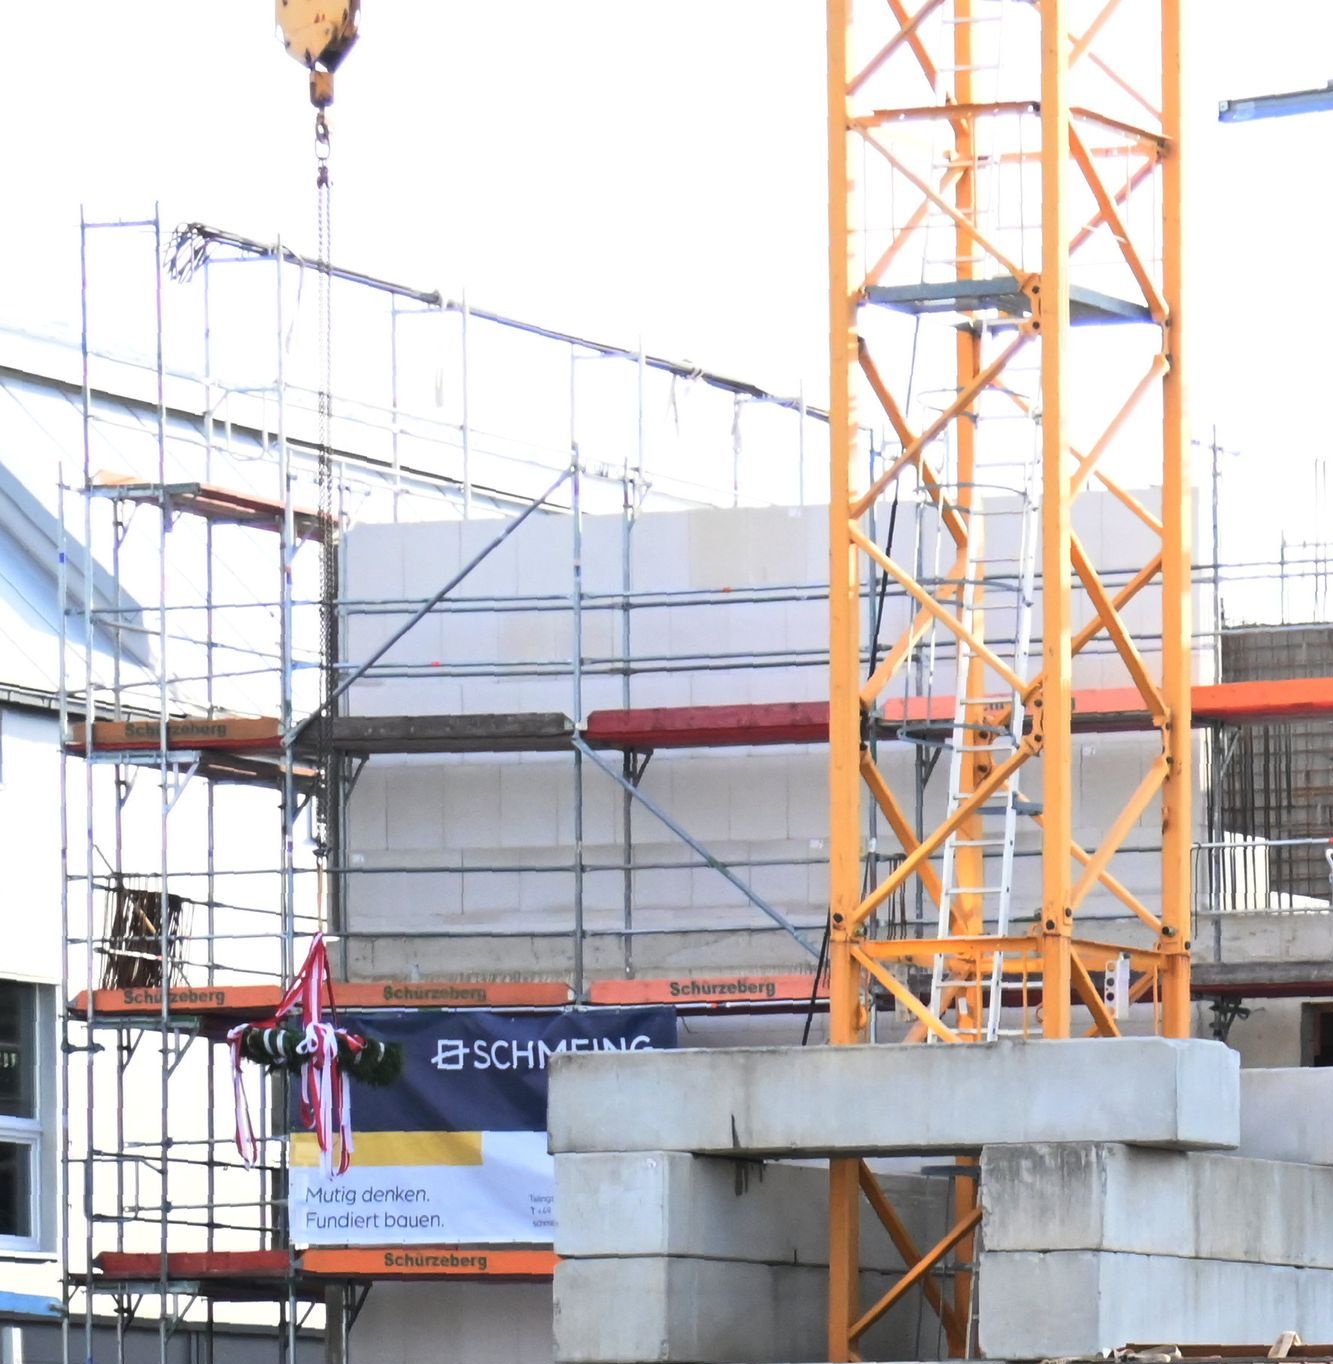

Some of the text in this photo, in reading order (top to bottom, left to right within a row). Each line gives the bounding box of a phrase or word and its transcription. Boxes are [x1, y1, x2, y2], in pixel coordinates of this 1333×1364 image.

[670, 980, 776, 998] Schürzeberg
[305, 1186, 430, 1206] Mutig denken.
[305, 1212, 445, 1229] Fundiert bauen.
[384, 1252, 488, 1271] Schürzeberg
